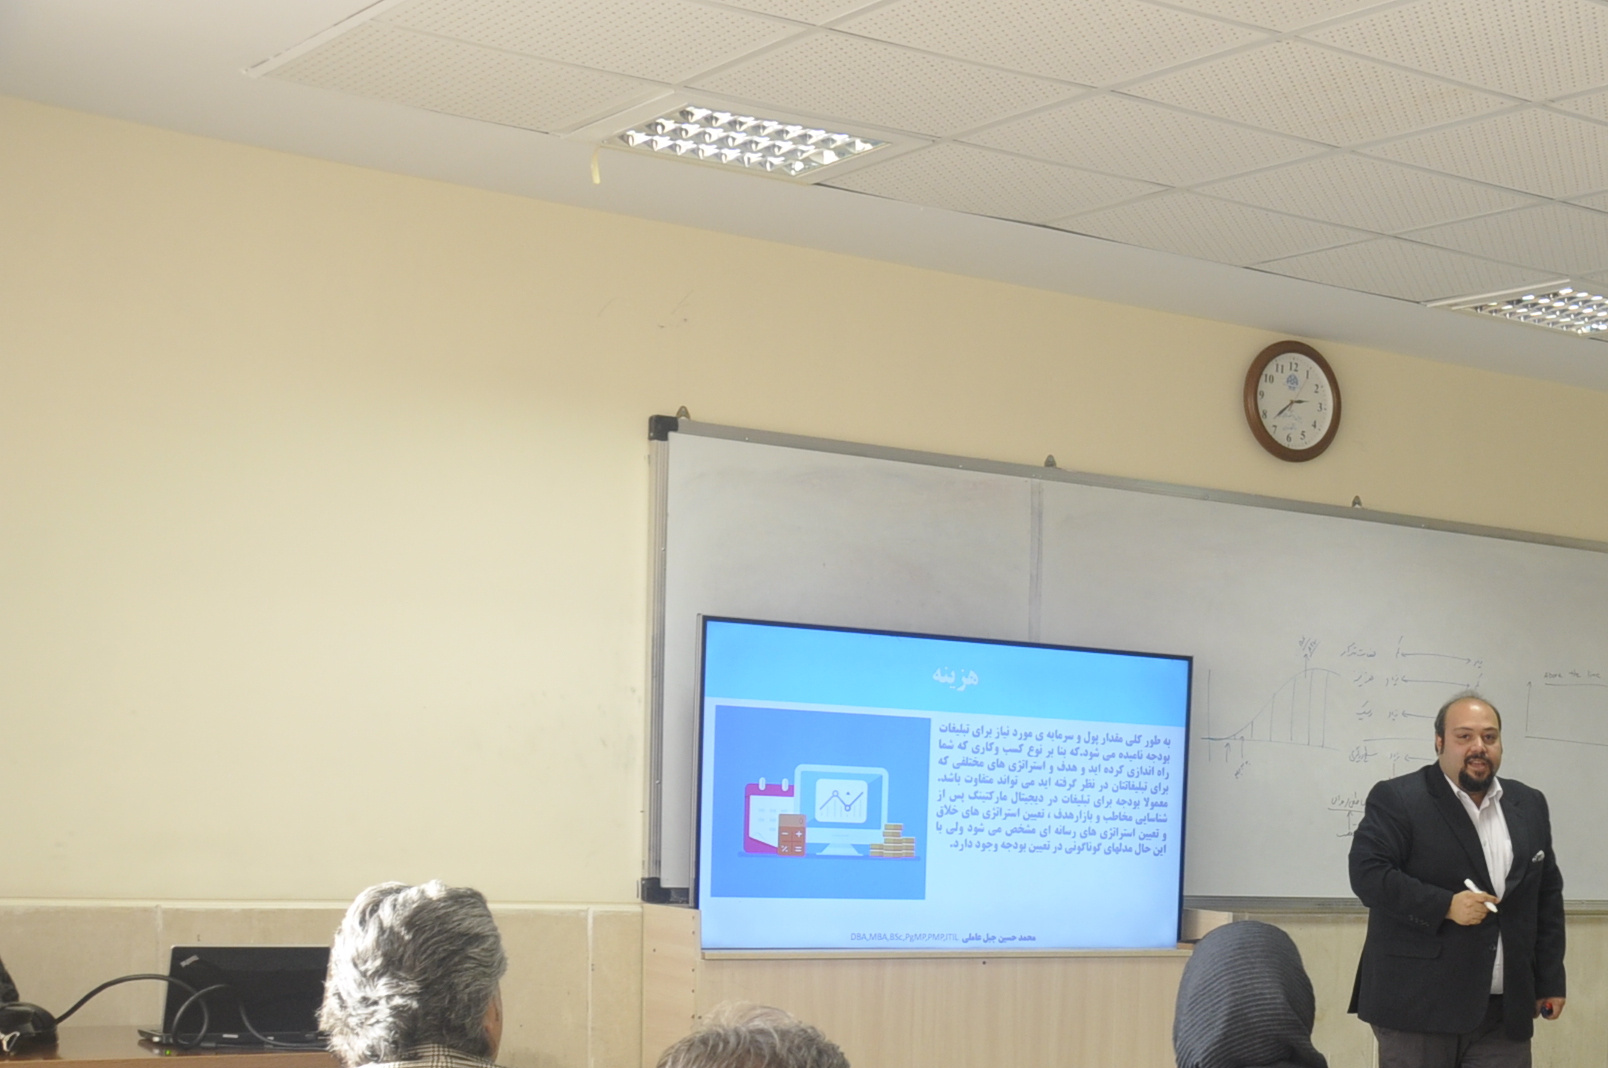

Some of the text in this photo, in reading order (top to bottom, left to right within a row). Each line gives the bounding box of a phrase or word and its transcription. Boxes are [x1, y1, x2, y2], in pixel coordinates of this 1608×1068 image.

[1275, 363, 1284, 374] 11
[1289, 361, 1299, 372] 12
[1264, 373, 1274, 384] 10
[932, 667, 979, 691] هزینه
[939, 722, 970, 737] تبلیغات
[971, 725, 992, 739] برای
[994, 725, 1010, 739] نیاز
[1012, 728, 1033, 741] مورد
[1035, 731, 1044, 741] ی
[1046, 729, 1074, 743] سرمایه
[938, 739, 955, 750] شما
[1083, 731, 1099, 745] پول
[1100, 732, 1123, 745] مقدار
[1125, 734, 1142, 747] کلی
[1144, 735, 1161, 748] طور
[1163, 736, 1171, 749] به
[957, 740, 969, 750] که
[1002, 743, 1024, 756] کسب
[1027, 744, 1043, 757] نوع
[1045, 748, 1054, 759] بر
[1057, 746, 1067, 759] بنا
[1102, 751, 1116, 762] می
[1118, 750, 1143, 762] نامیده
[1146, 753, 1171, 765] بودجه
[938, 755, 950, 766] که
[952, 756, 985, 769] مختلفی
[987, 758, 1006, 771] های
[1008, 759, 1046, 773] استراتژی
[1056, 760, 1078, 772] هدف
[1088, 764, 1101, 776] اید
[1103, 764, 1125, 777] کرده
[1126, 765, 1155, 778] اندازی
[1157, 767, 1169, 780] راه
[937, 772, 1169, 795] برای تبلیغاتتان در نظر گرفته اید می تواند متفاوت باشد.
[937, 788, 1169, 810] معمولا بودجه برای تبلیغات در دیجیتال مارکتینگ پس از
[936, 804, 959, 818] خلاق
[961, 805, 980, 819] های
[982, 806, 1020, 821] استراتژی
[1022, 808, 1045, 821] تعیین
[1102, 811, 1133, 824] مخاطب
[1135, 812, 1168, 825] شناسایی
[936, 821, 943, 834] با
[945, 821, 964, 835] ولی
[967, 822, 985, 836] شود
[988, 826, 1002, 836] می
[1005, 823, 1036, 837] مشخص
[1039, 824, 1051, 838] ای
[1054, 825, 1076, 839] رسانه
[1079, 826, 1097, 839] های
[1099, 827, 1136, 841] استراتژی
[1138, 828, 1160, 841] تعیین
[949, 838, 1167, 857] این حال مدلهای گوناگونی در تعیین بودجه وجود دارد.
[961, 932, 982, 944] عاملی
[998, 935, 1017, 944] حسین
